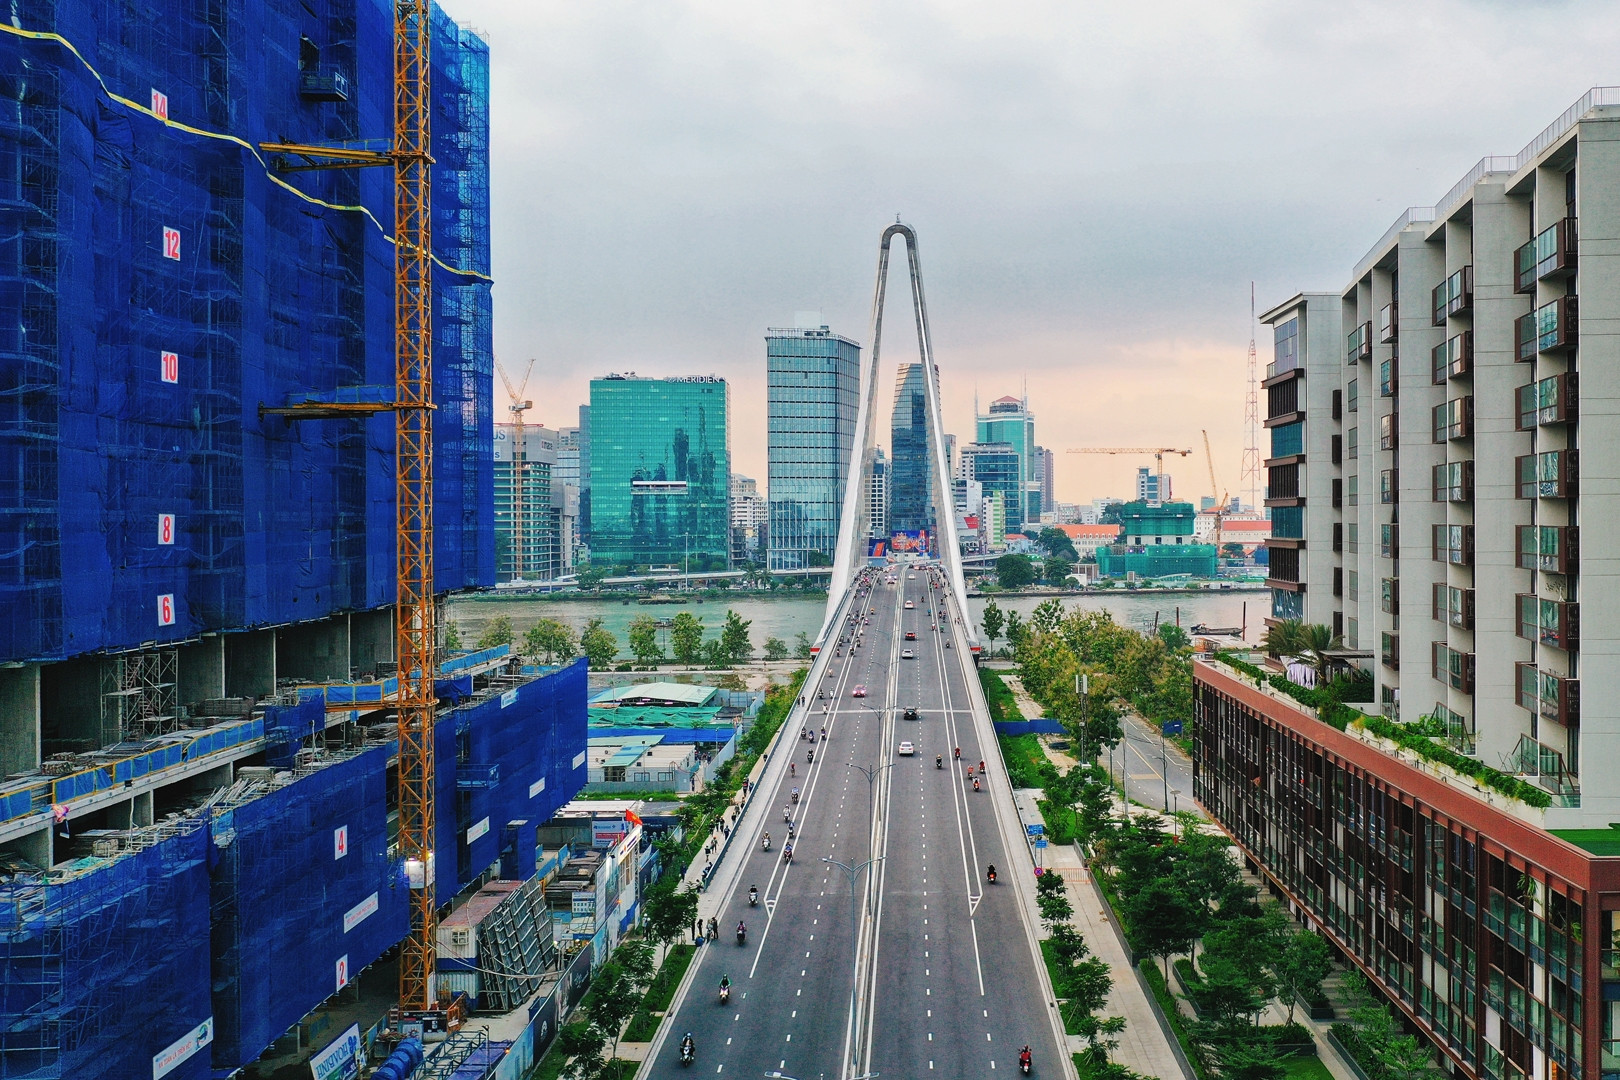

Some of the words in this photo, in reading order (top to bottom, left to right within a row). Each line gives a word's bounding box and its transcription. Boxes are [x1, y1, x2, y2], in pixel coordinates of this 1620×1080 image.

[153, 93, 166, 118] 14
[165, 230, 179, 259] 12
[163, 354, 176, 381] 10
[163, 516, 171, 543] 8
[162, 596, 171, 624] 6
[338, 830, 345, 853] 4
[409, 873, 424, 884] C2
[339, 961, 345, 985] 2
